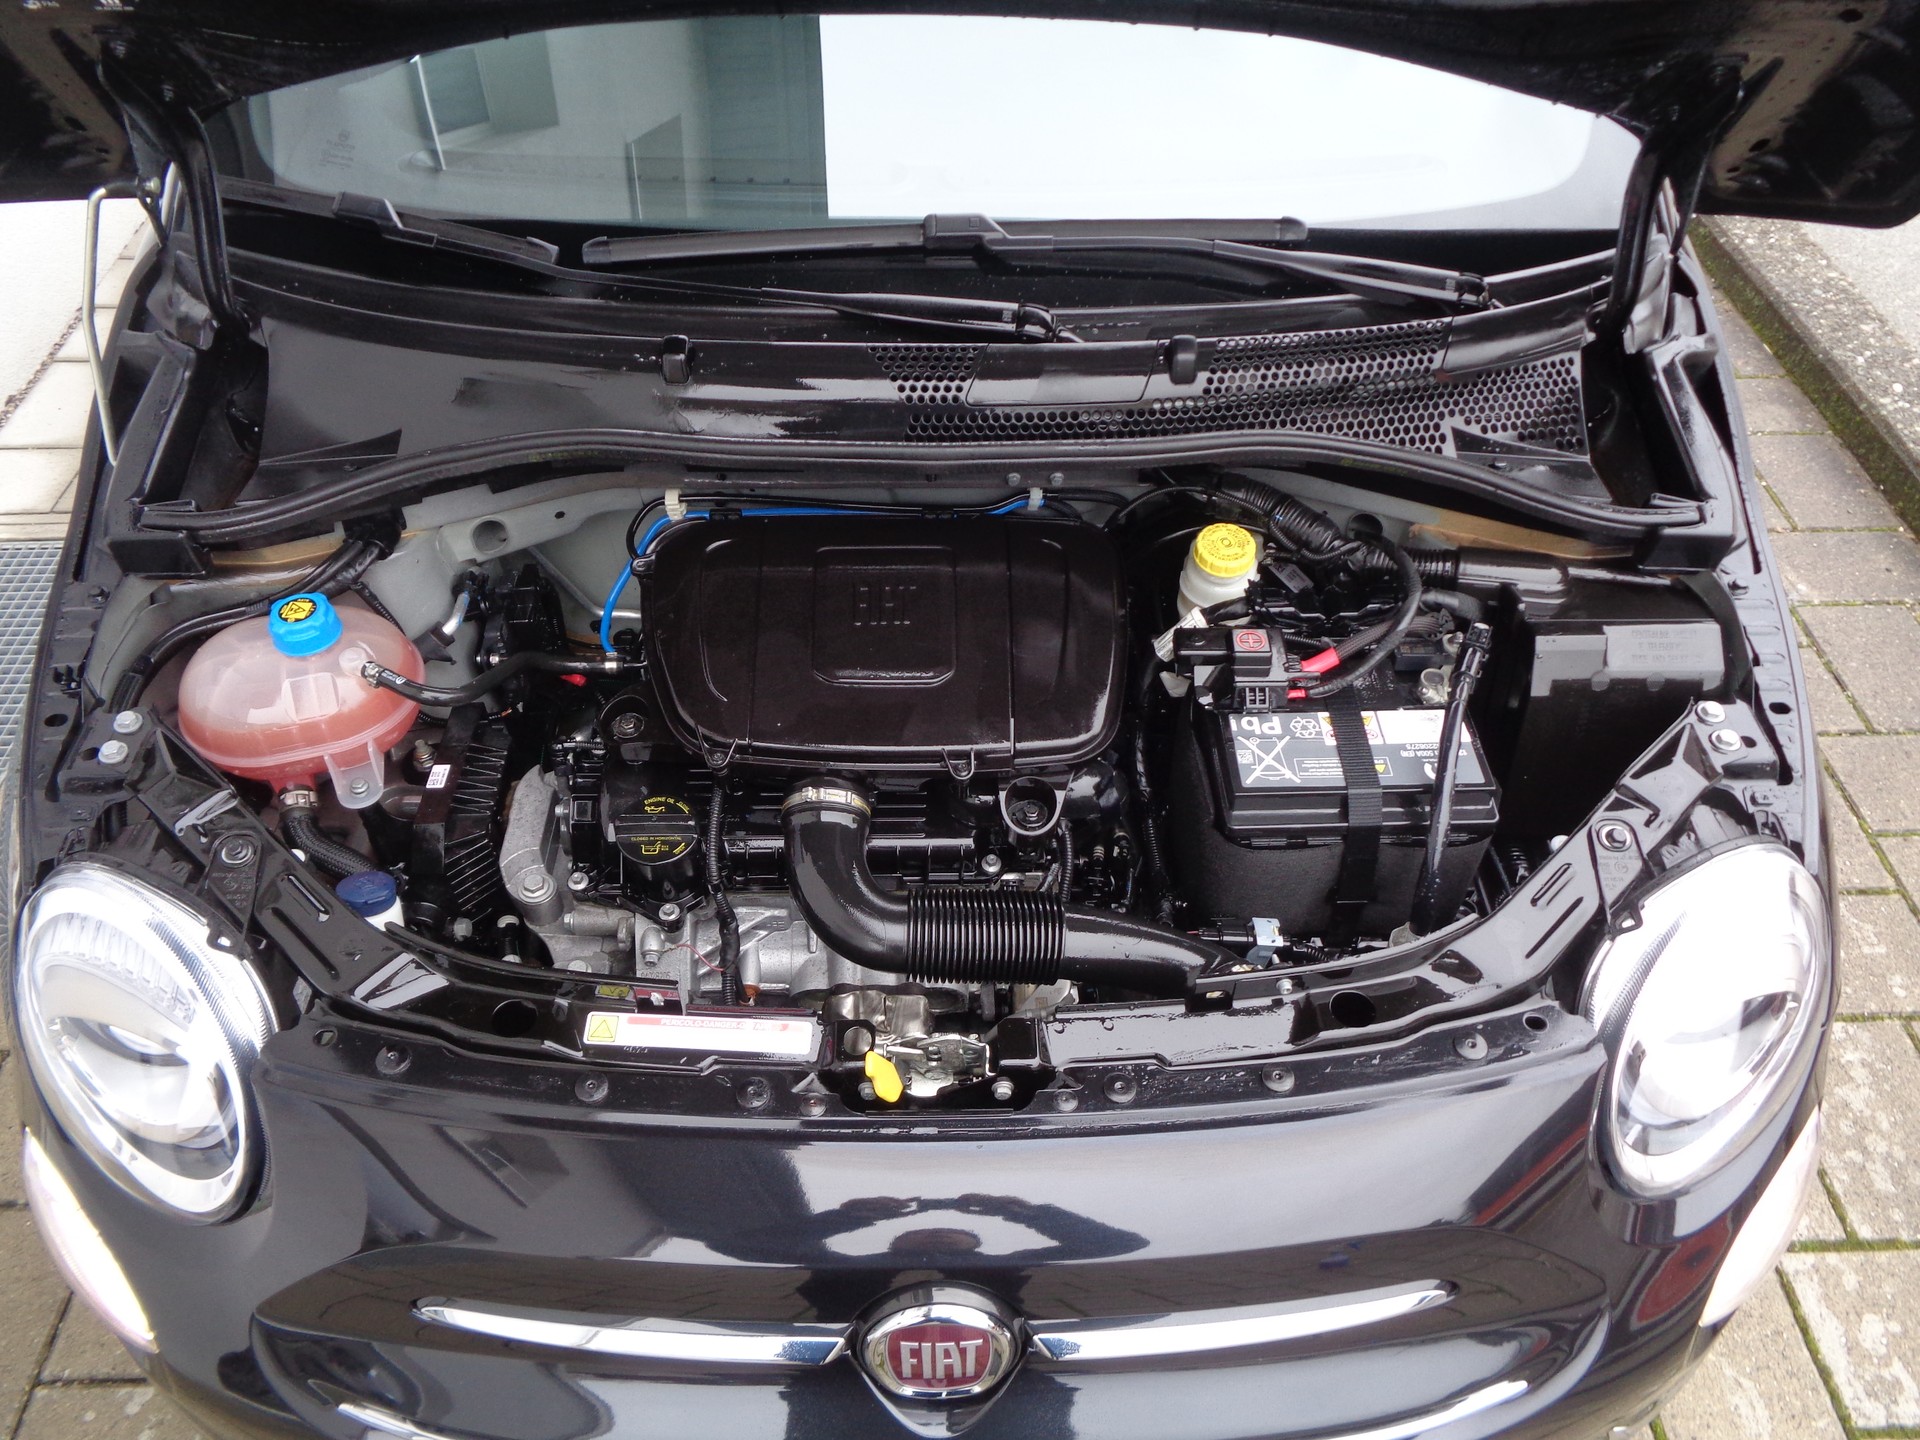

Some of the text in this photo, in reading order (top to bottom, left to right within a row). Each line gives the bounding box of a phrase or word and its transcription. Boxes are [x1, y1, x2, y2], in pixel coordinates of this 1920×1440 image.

[1244, 715, 1282, 735] Pb
[644, 797, 666, 805] ENGINE
[900, 1338, 983, 1380] FIAT
